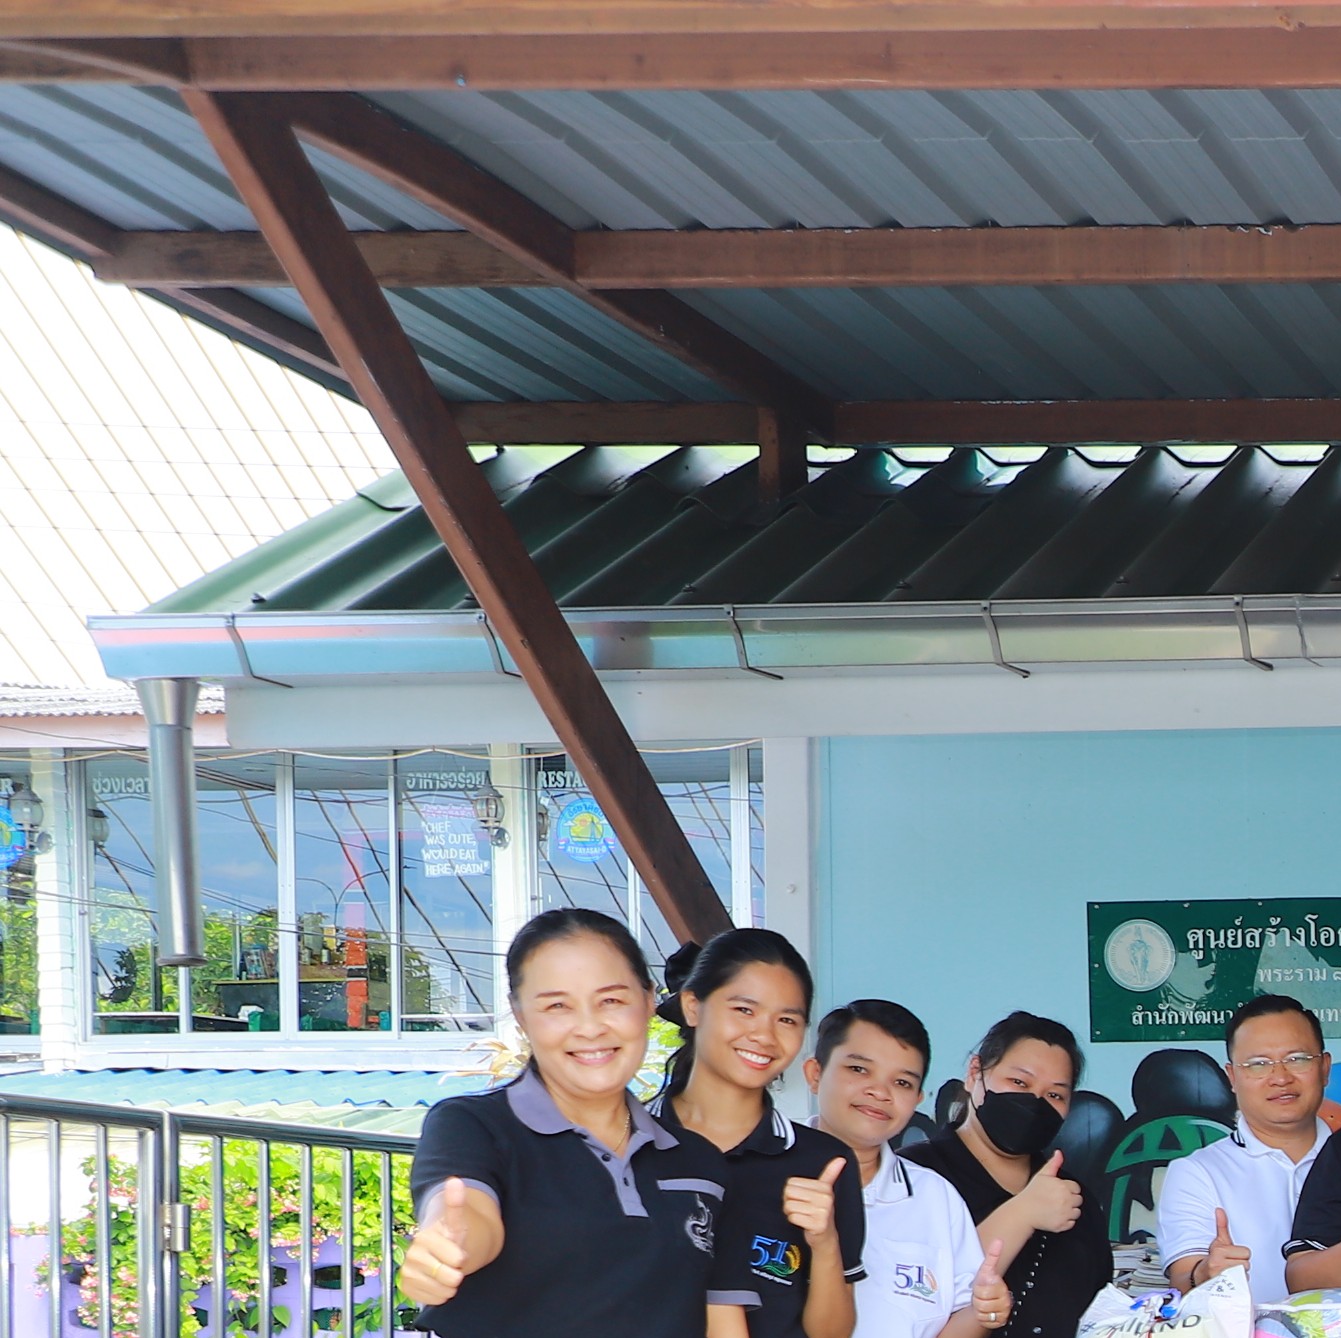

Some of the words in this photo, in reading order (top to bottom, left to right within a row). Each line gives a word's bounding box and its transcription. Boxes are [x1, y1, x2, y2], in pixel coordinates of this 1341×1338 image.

[424, 834, 445, 845] WAS
[459, 849, 475, 860] EAT
[425, 863, 451, 876] HERE
[1257, 968, 1327, 983] พระราม
[1131, 1003, 1234, 1026] สำนักพัฒนา
[750, 1234, 789, 1266] 51
[893, 1263, 926, 1289] 51
